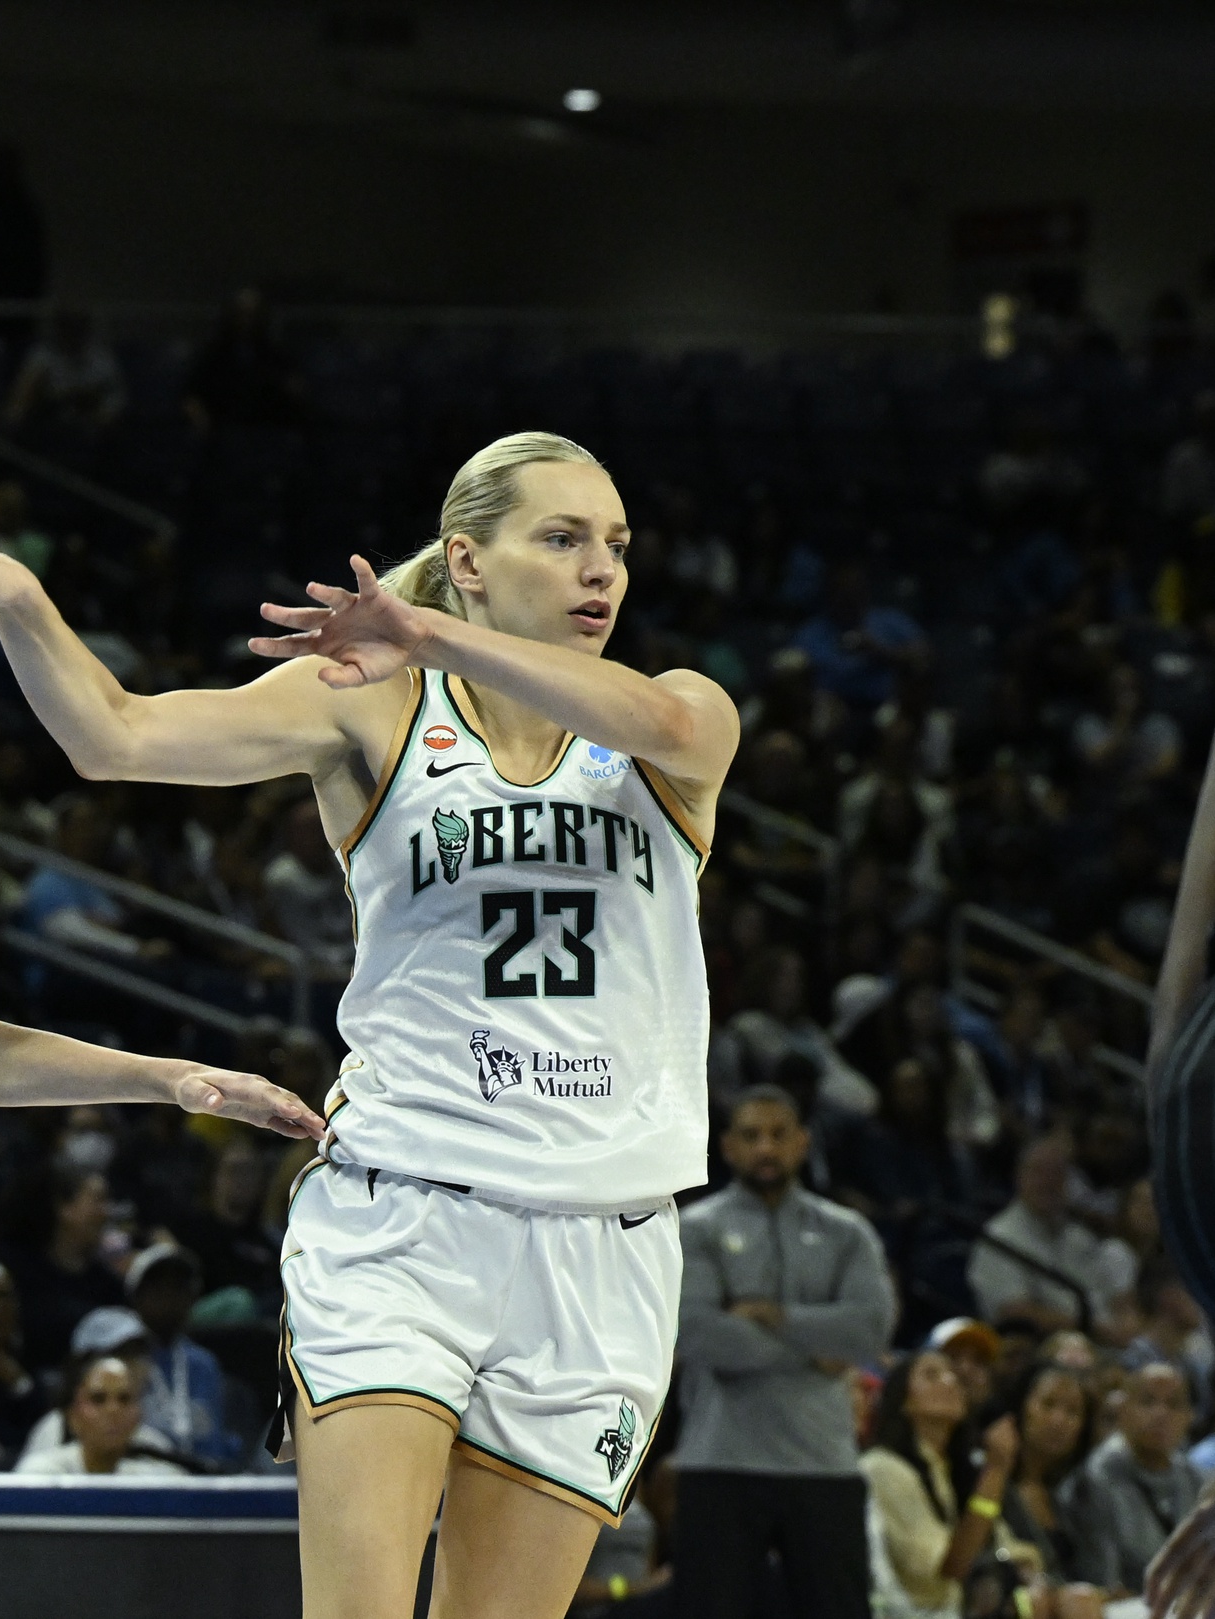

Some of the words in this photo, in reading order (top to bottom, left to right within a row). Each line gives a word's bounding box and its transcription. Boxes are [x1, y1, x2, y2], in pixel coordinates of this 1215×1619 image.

[480, 889, 597, 999] 23
[531, 1051, 612, 1081] Liberty
[532, 1076, 612, 1098] Mutual
